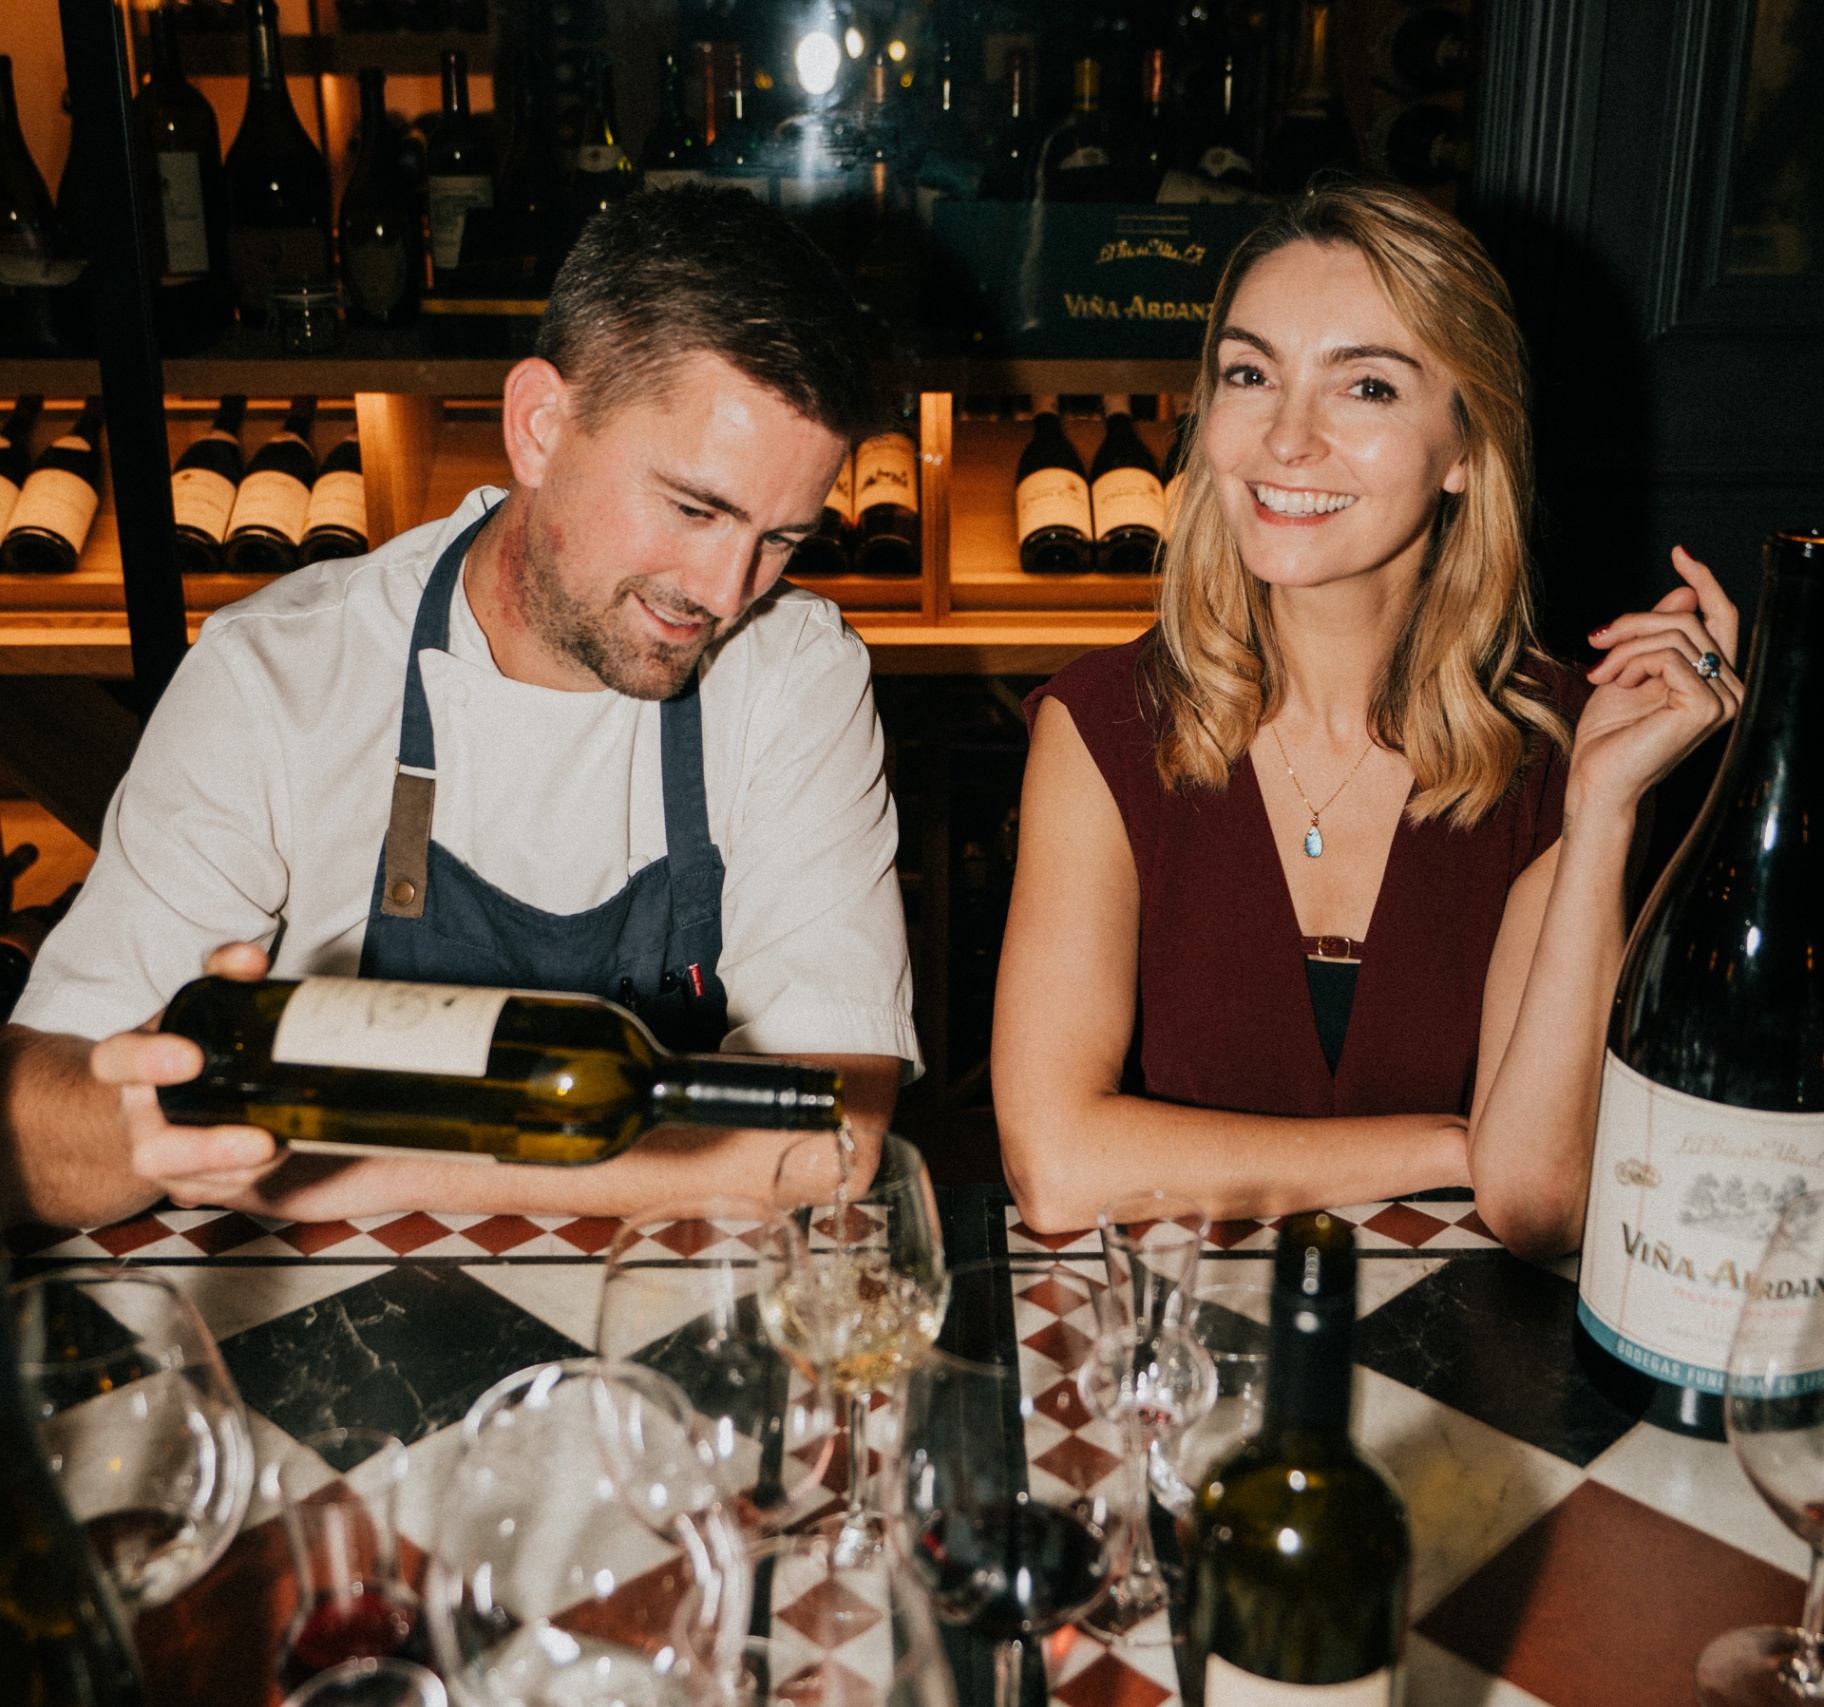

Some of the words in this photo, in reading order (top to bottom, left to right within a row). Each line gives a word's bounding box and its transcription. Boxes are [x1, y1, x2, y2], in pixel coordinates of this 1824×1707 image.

[1063, 292, 1119, 319] VIÑA
[1622, 1221, 1693, 1282] VIÑA
[1617, 1338, 1681, 1380] BODEGAS
